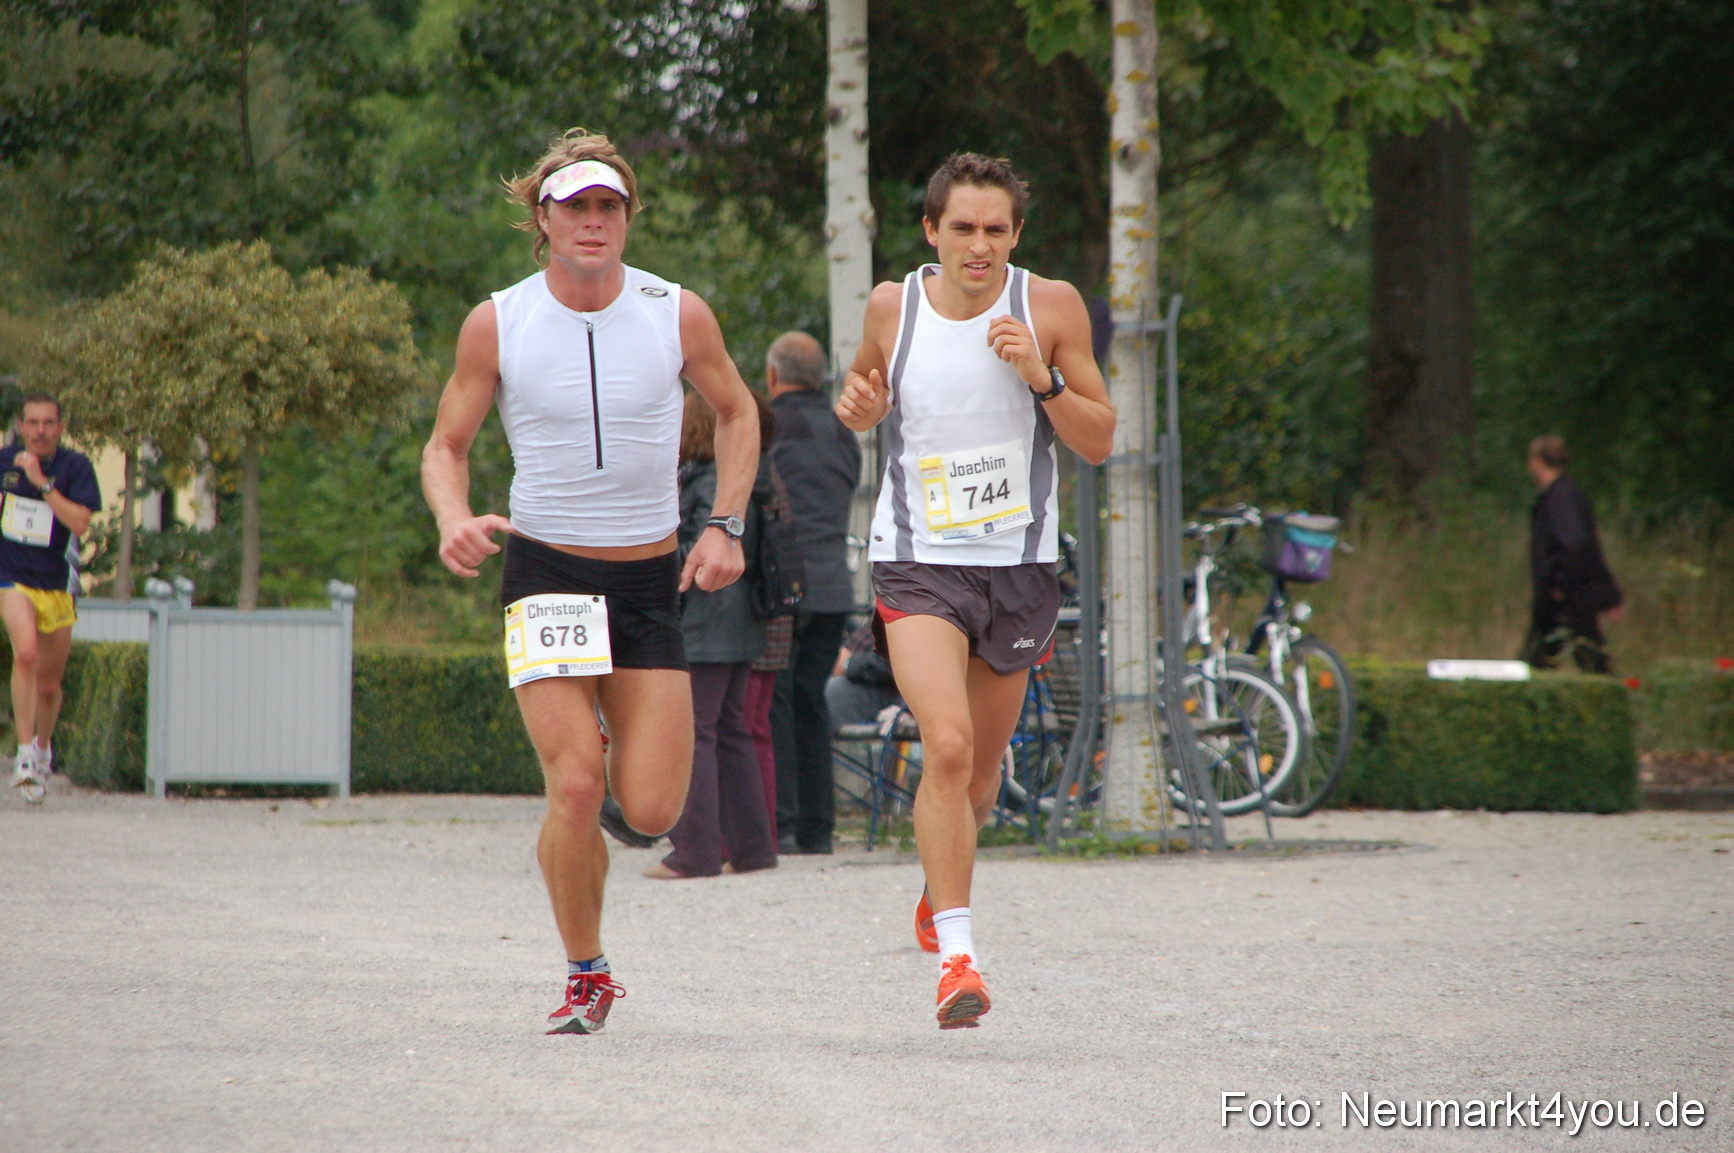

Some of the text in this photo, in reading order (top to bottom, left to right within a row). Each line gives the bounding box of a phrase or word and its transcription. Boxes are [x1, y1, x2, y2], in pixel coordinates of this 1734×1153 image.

[949, 456, 1006, 478] Joachim
[930, 490, 936, 502] A
[963, 478, 1011, 510] 744
[994, 511, 1029, 526] PFLEIDERER
[527, 601, 592, 619] Christoph
[510, 634, 516, 645] A
[540, 624, 588, 647] 678
[569, 661, 610, 671] PFLEIDERER
